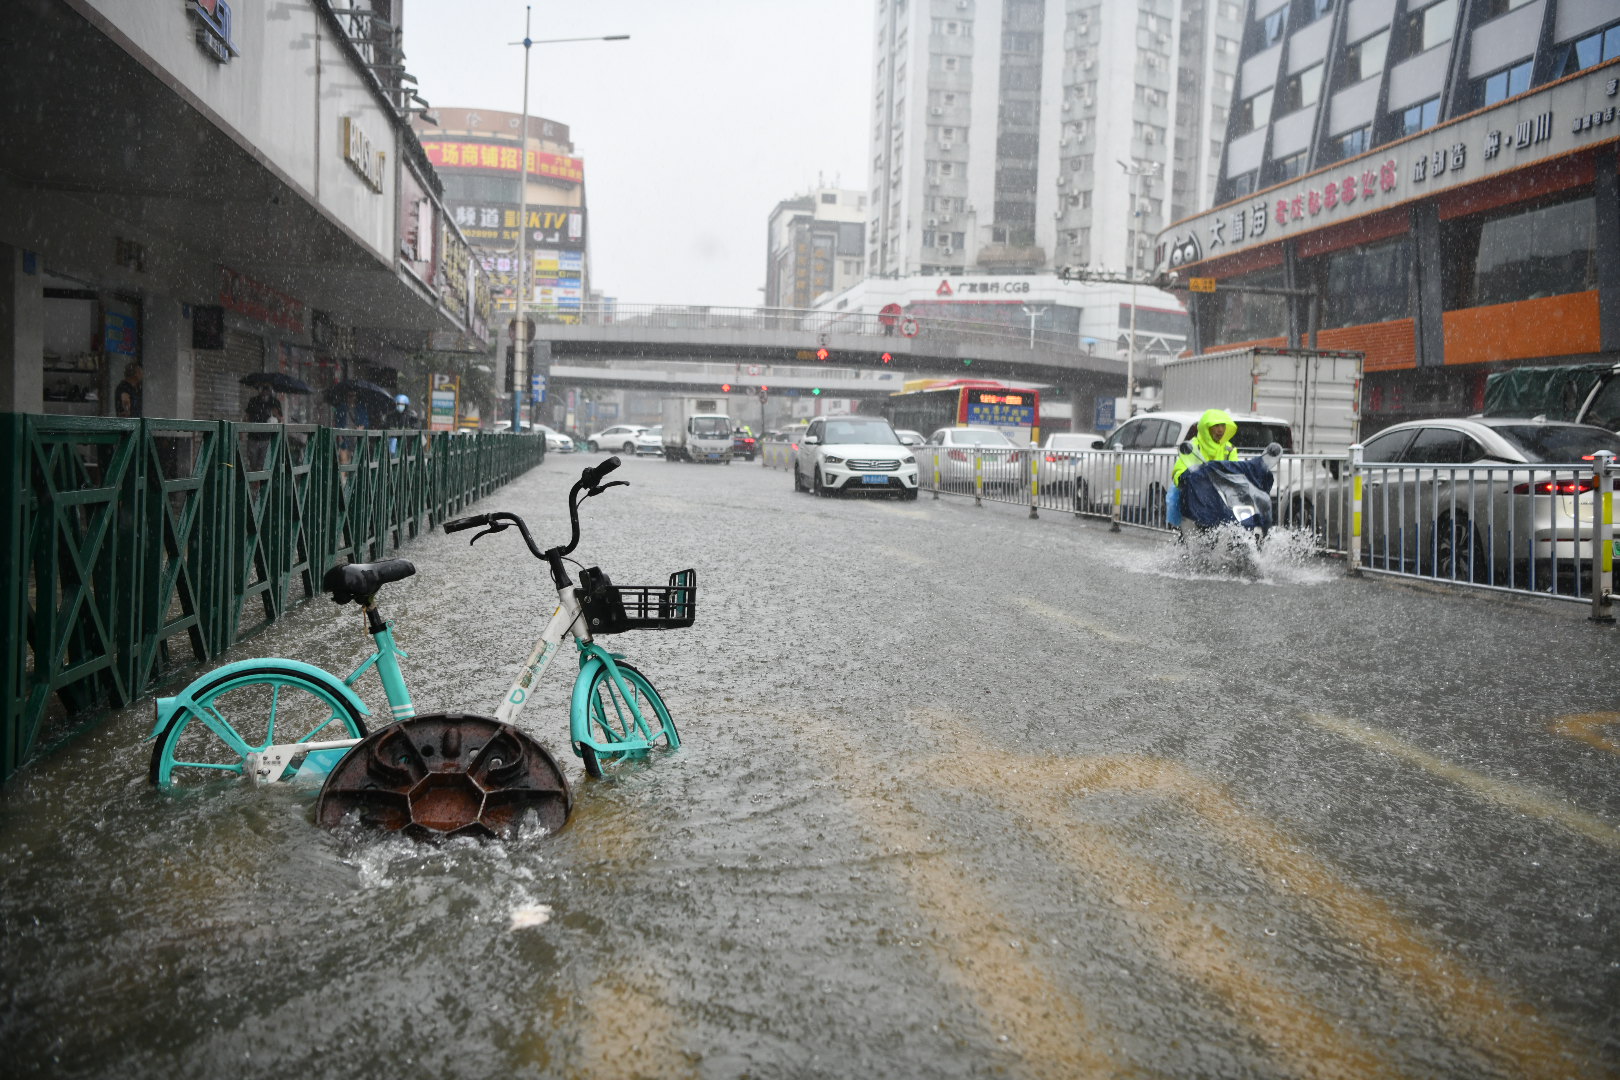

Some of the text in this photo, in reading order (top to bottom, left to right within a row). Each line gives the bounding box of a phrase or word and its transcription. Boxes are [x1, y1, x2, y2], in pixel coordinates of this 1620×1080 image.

[958, 282, 1030, 293] 广发银行 CGB
